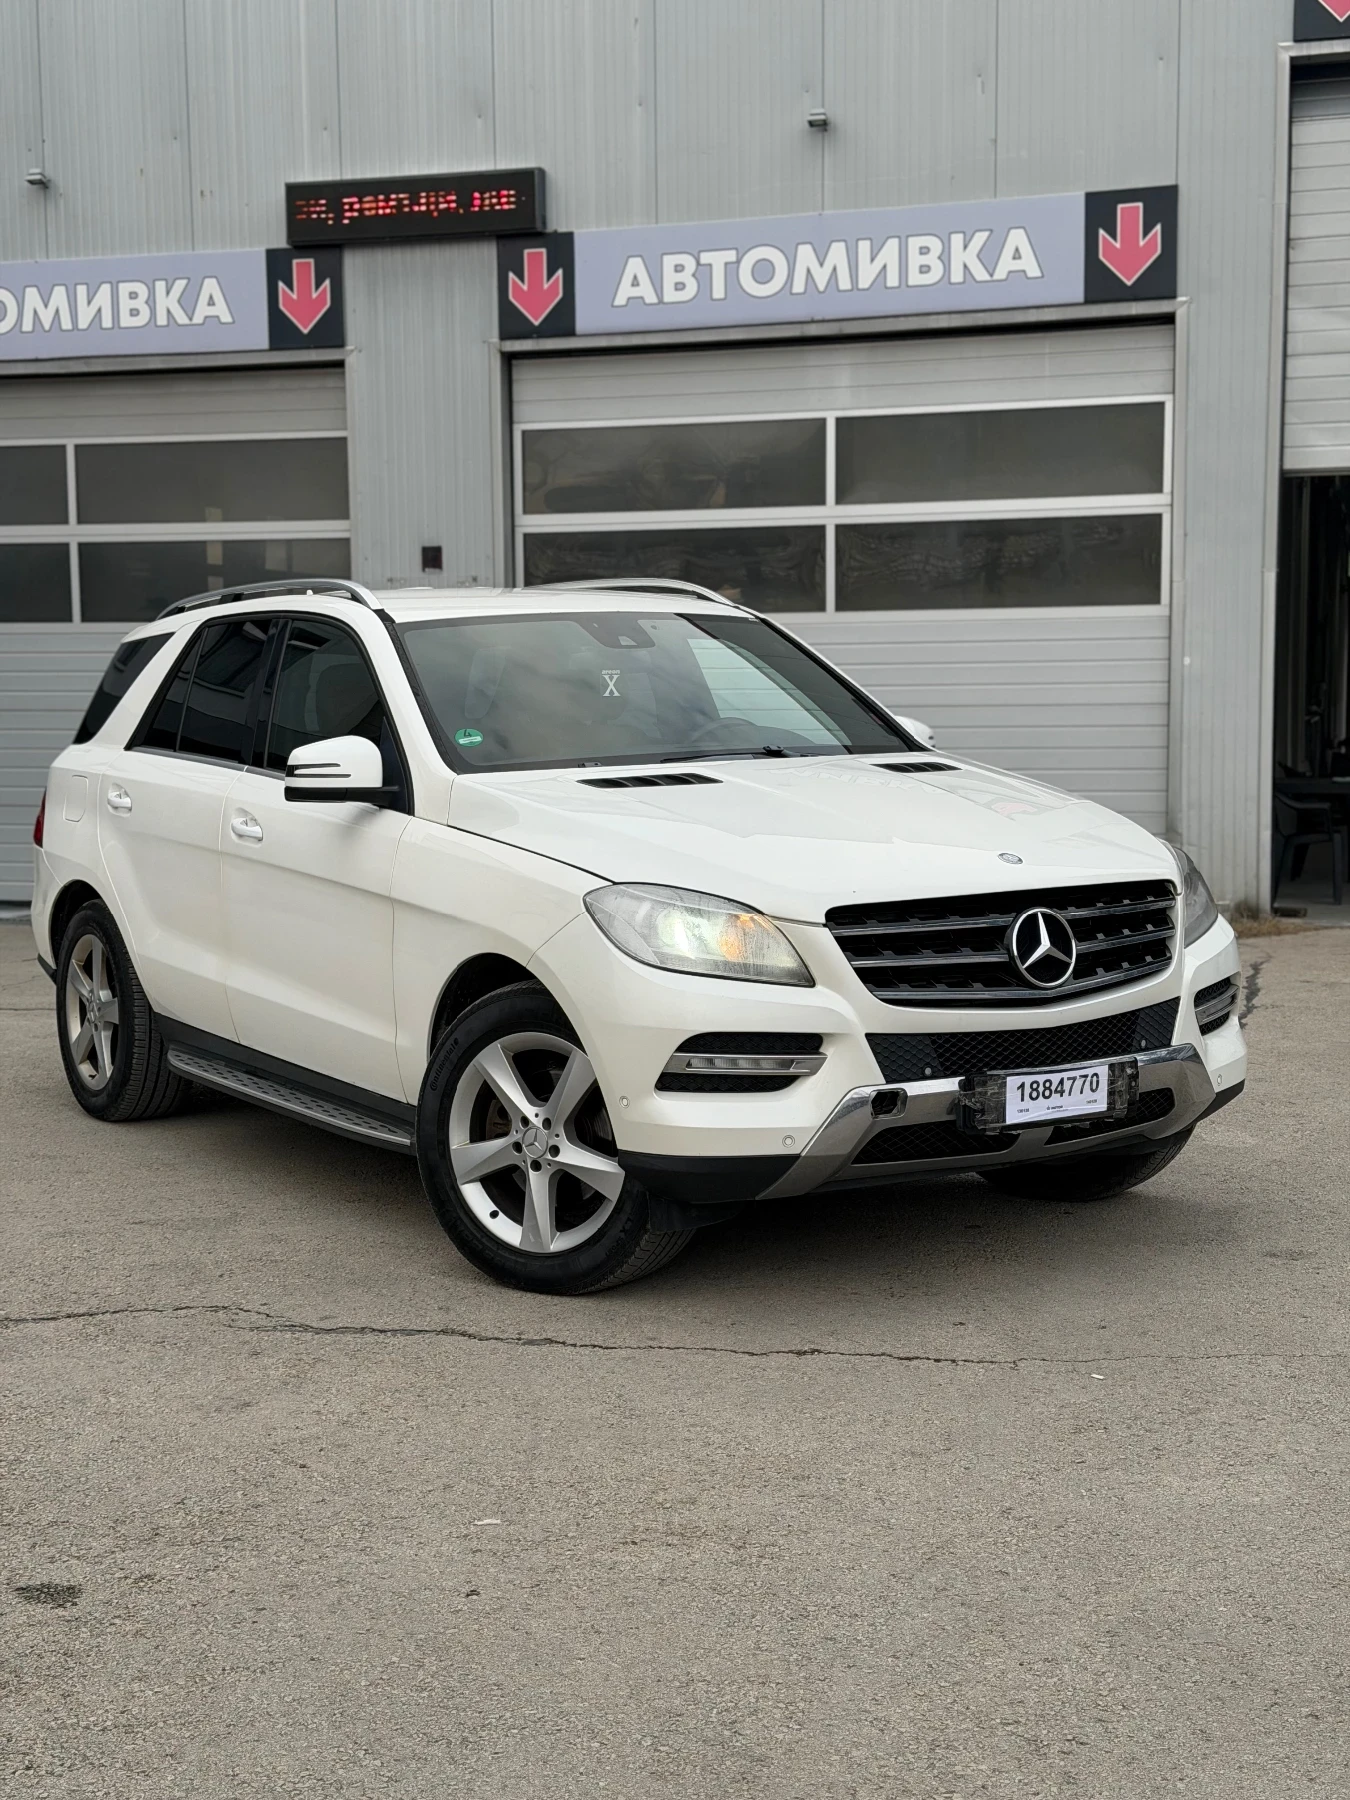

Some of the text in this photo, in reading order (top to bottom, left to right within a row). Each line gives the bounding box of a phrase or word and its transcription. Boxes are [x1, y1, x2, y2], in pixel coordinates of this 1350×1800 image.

[611, 226, 1044, 307] АВТОМИВКА
[602, 674, 621, 696] X
[1016, 1072, 1100, 1102] 1884770
